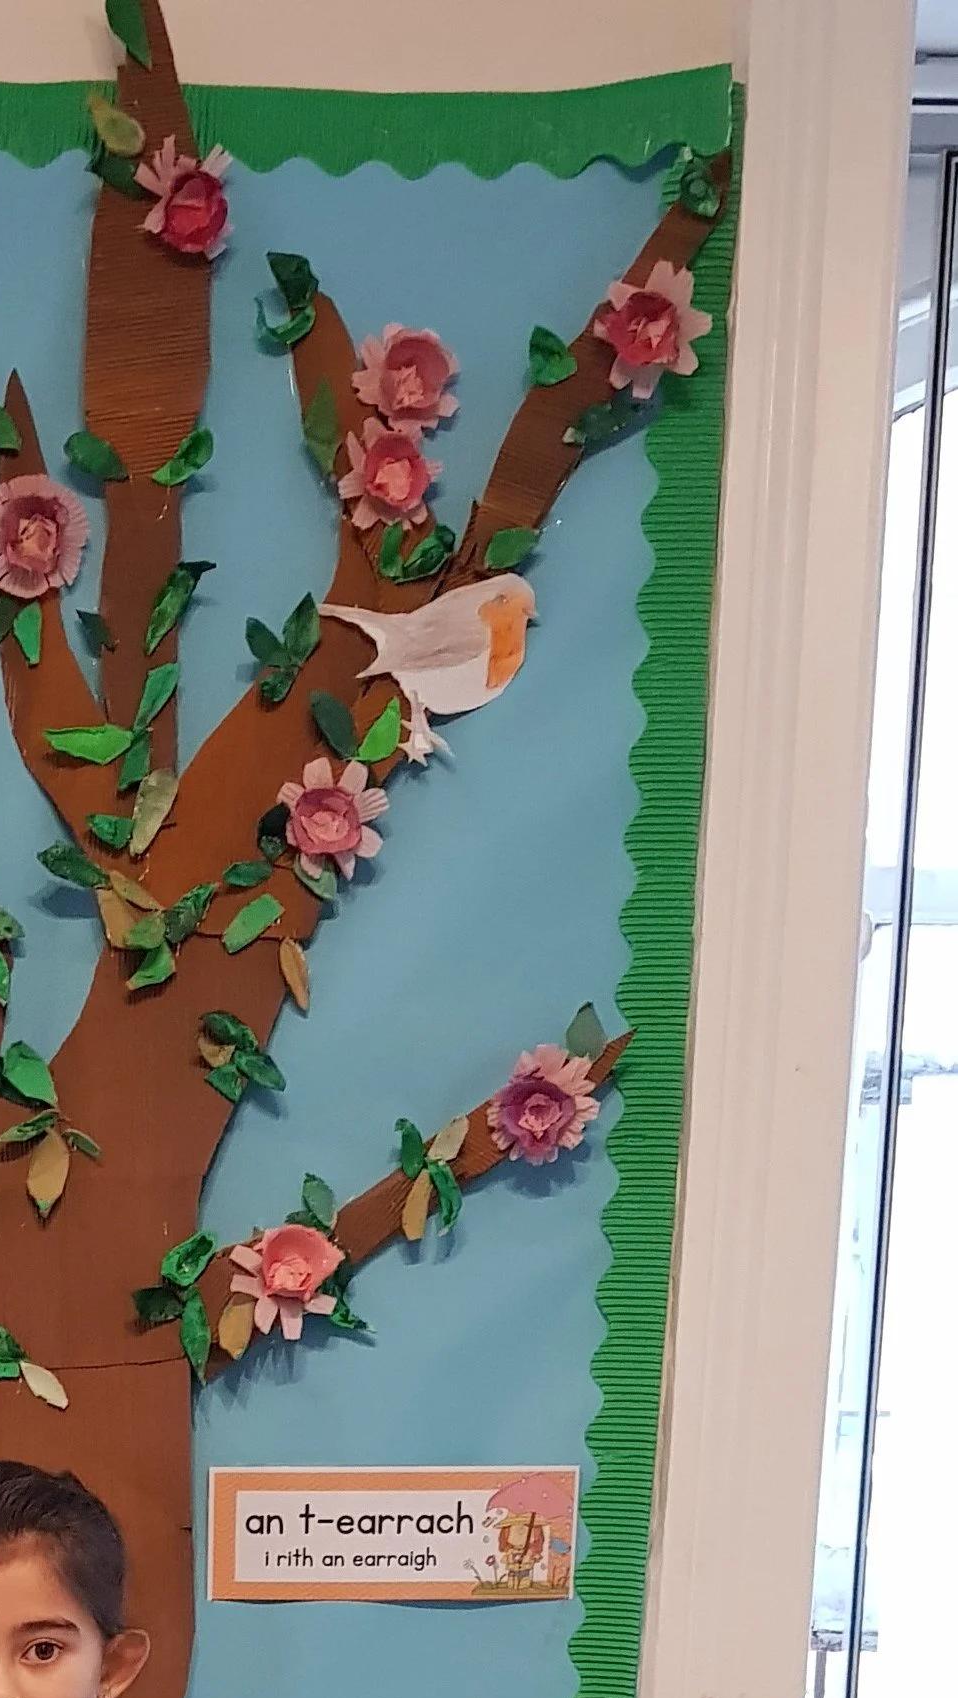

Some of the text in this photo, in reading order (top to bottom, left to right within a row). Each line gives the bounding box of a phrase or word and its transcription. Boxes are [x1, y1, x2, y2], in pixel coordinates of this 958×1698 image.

[245, 1501, 474, 1535] an t-earrach
[264, 1547, 438, 1571] i rith an earraigh
